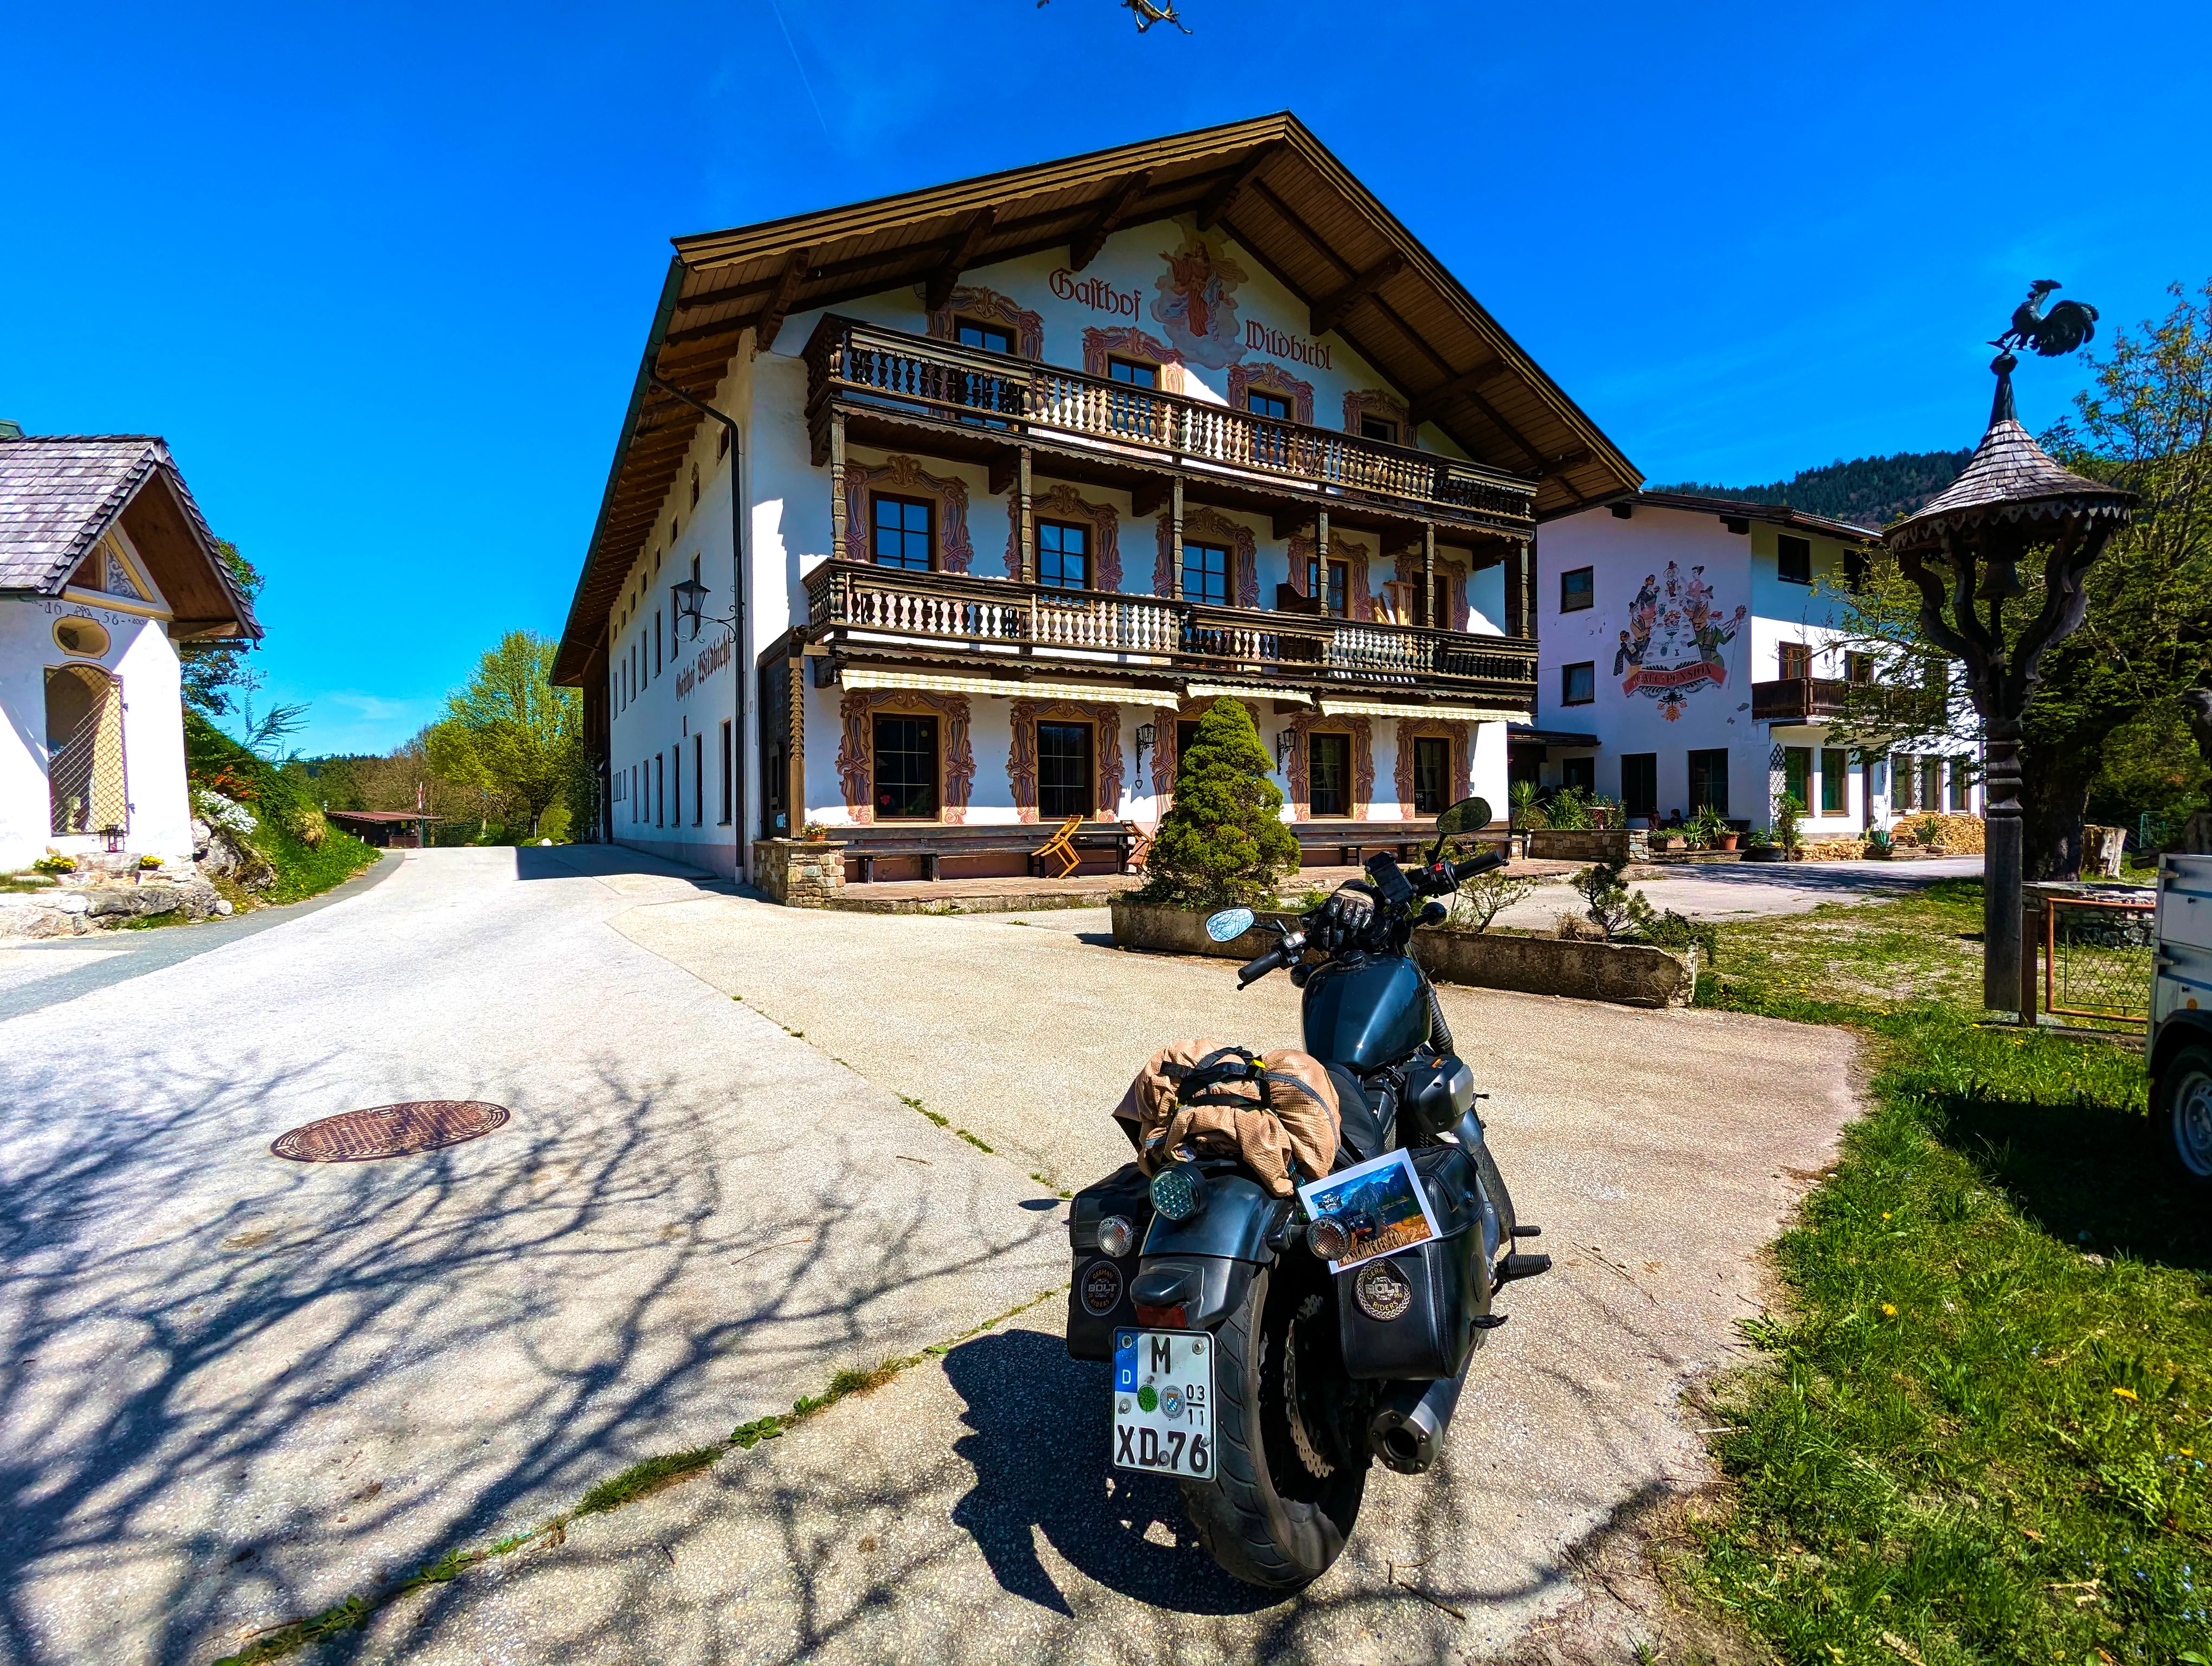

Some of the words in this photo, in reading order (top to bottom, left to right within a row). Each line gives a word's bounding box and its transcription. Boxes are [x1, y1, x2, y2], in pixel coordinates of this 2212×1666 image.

[1049, 267, 1142, 322] Gasthof
[1245, 319, 1333, 370] Wildbichl
[1088, 1284, 1117, 1292] BOLT
[1365, 1283, 1401, 1294] BOLT
[1372, 1300, 1399, 1311] RIDERS
[1151, 1336, 1171, 1374] M
[1122, 1369, 1131, 1385] D
[1187, 1383, 1205, 1401] 03
[1188, 1408, 1204, 1426] 11
